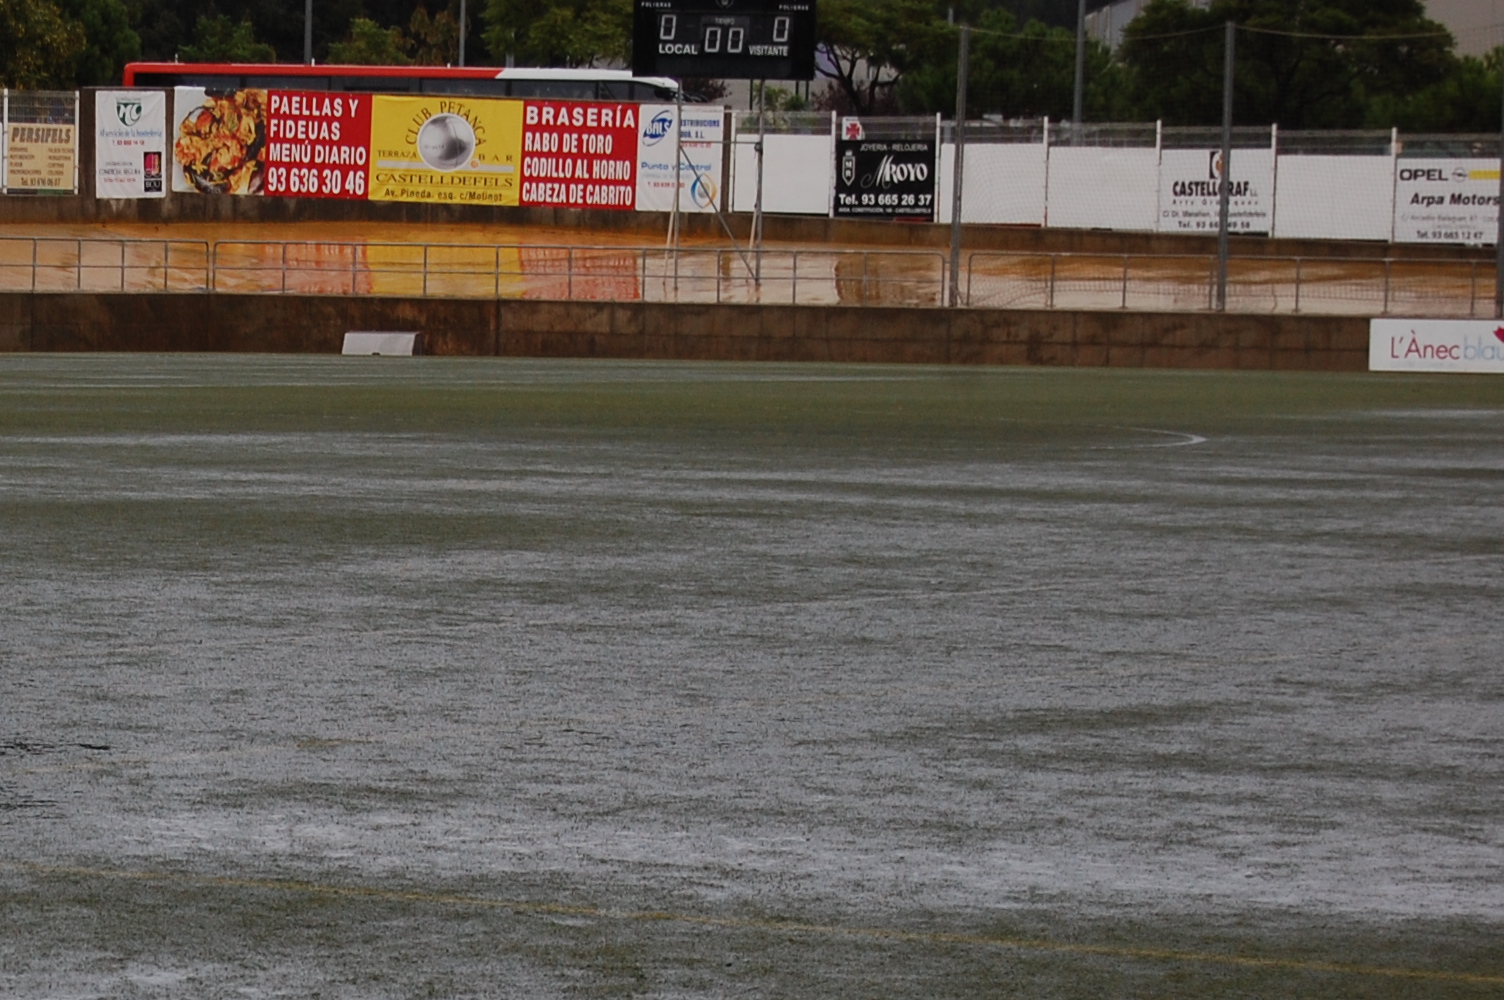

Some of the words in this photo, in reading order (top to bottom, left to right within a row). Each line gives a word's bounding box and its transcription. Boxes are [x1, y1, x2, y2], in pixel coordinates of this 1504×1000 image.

[658, 43, 699, 55] LOCAL
[748, 44, 789, 57] VISITANTE
[270, 96, 343, 118] PAELLAS
[348, 98, 359, 118] Y
[439, 100, 488, 148] PETANCA
[525, 105, 636, 129] BRASERÍA
[270, 118, 341, 141] FIDEUAS
[404, 106, 433, 146] CLUB
[11, 126, 72, 145] PERSIFELS
[524, 131, 559, 153] RABO
[562, 133, 578, 154] DE
[581, 134, 613, 155] TORO
[269, 140, 311, 163] MENÚ
[314, 146, 367, 165] DIARIO
[377, 150, 418, 159] TERRAZA
[860, 143, 888, 151] JOYERIA
[891, 143, 929, 152] RELOJERIA
[523, 156, 573, 179] CODILLO
[575, 158, 590, 179] AL
[592, 160, 631, 181] HORNO
[641, 161, 669, 171] Punto
[679, 162, 712, 172] Control
[1399, 168, 1449, 182] OPEL
[267, 166, 286, 191] 93
[289, 168, 318, 193] 636
[322, 169, 342, 194] 30
[344, 171, 365, 195] 46
[375, 173, 514, 188] CASTELLDEFELS
[1172, 180, 1250, 197] CASTELLRAF
[383, 188, 398, 199] Av.
[437, 191, 456, 201] esq.
[522, 181, 566, 204] CABEZA
[568, 183, 584, 204] DE
[586, 185, 633, 206] CABRITO
[839, 193, 859, 206] Tel.
[861, 193, 875, 206] 93
[877, 193, 899, 206] 665
[901, 194, 916, 206] 26
[917, 194, 932, 206] 37
[1410, 192, 1445, 208] Arpa
[1448, 192, 1502, 207] Motors
[1178, 220, 1192, 228] Tel.
[1416, 230, 1430, 239] Tel.
[1432, 231, 1442, 239] 93
[1390, 329, 1461, 360] L'Ànec
